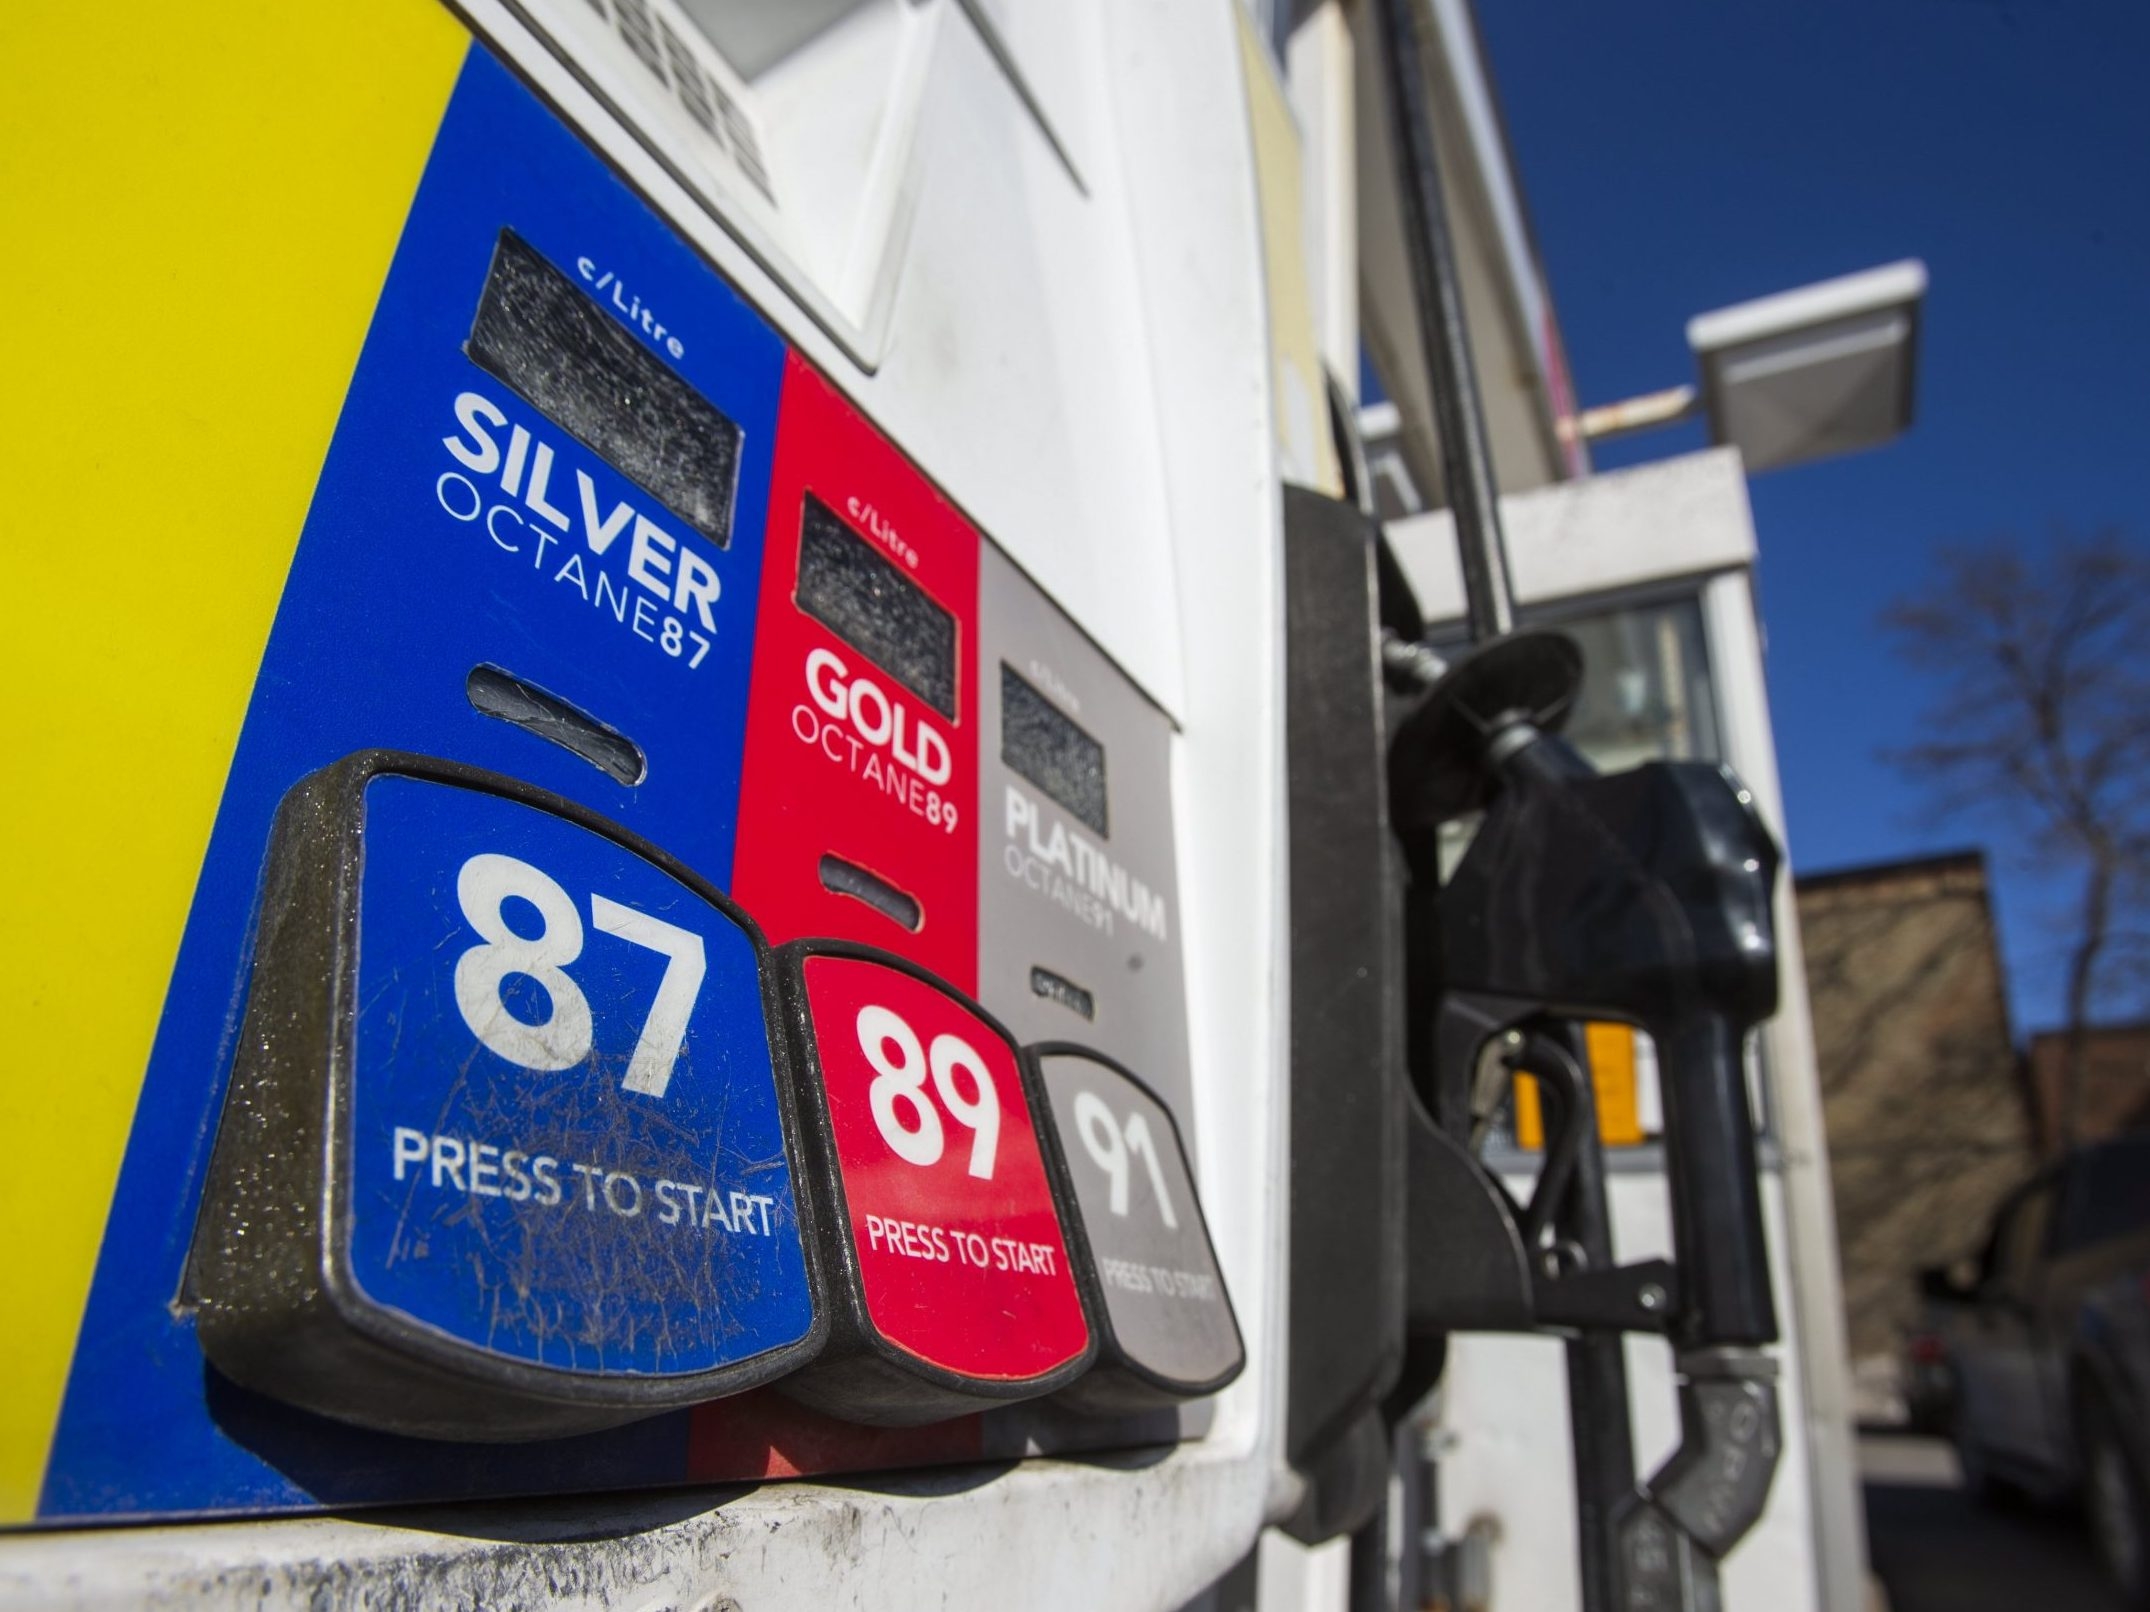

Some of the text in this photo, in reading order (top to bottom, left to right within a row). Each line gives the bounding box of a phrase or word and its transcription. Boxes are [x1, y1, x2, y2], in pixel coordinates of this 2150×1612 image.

[577, 256, 684, 360] c/Litre
[442, 391, 722, 634] SILVER
[846, 495, 918, 569] c/Litre
[805, 648, 951, 786] GOLD
[1005, 786, 1167, 941] PLATINUM
[454, 853, 707, 1099] 87
[856, 1004, 1000, 1181] 89
[1074, 1091, 1178, 1229] 91
[393, 1126, 774, 1237] PRESS TO START
[865, 1213, 1057, 1276] PRESS TO START
